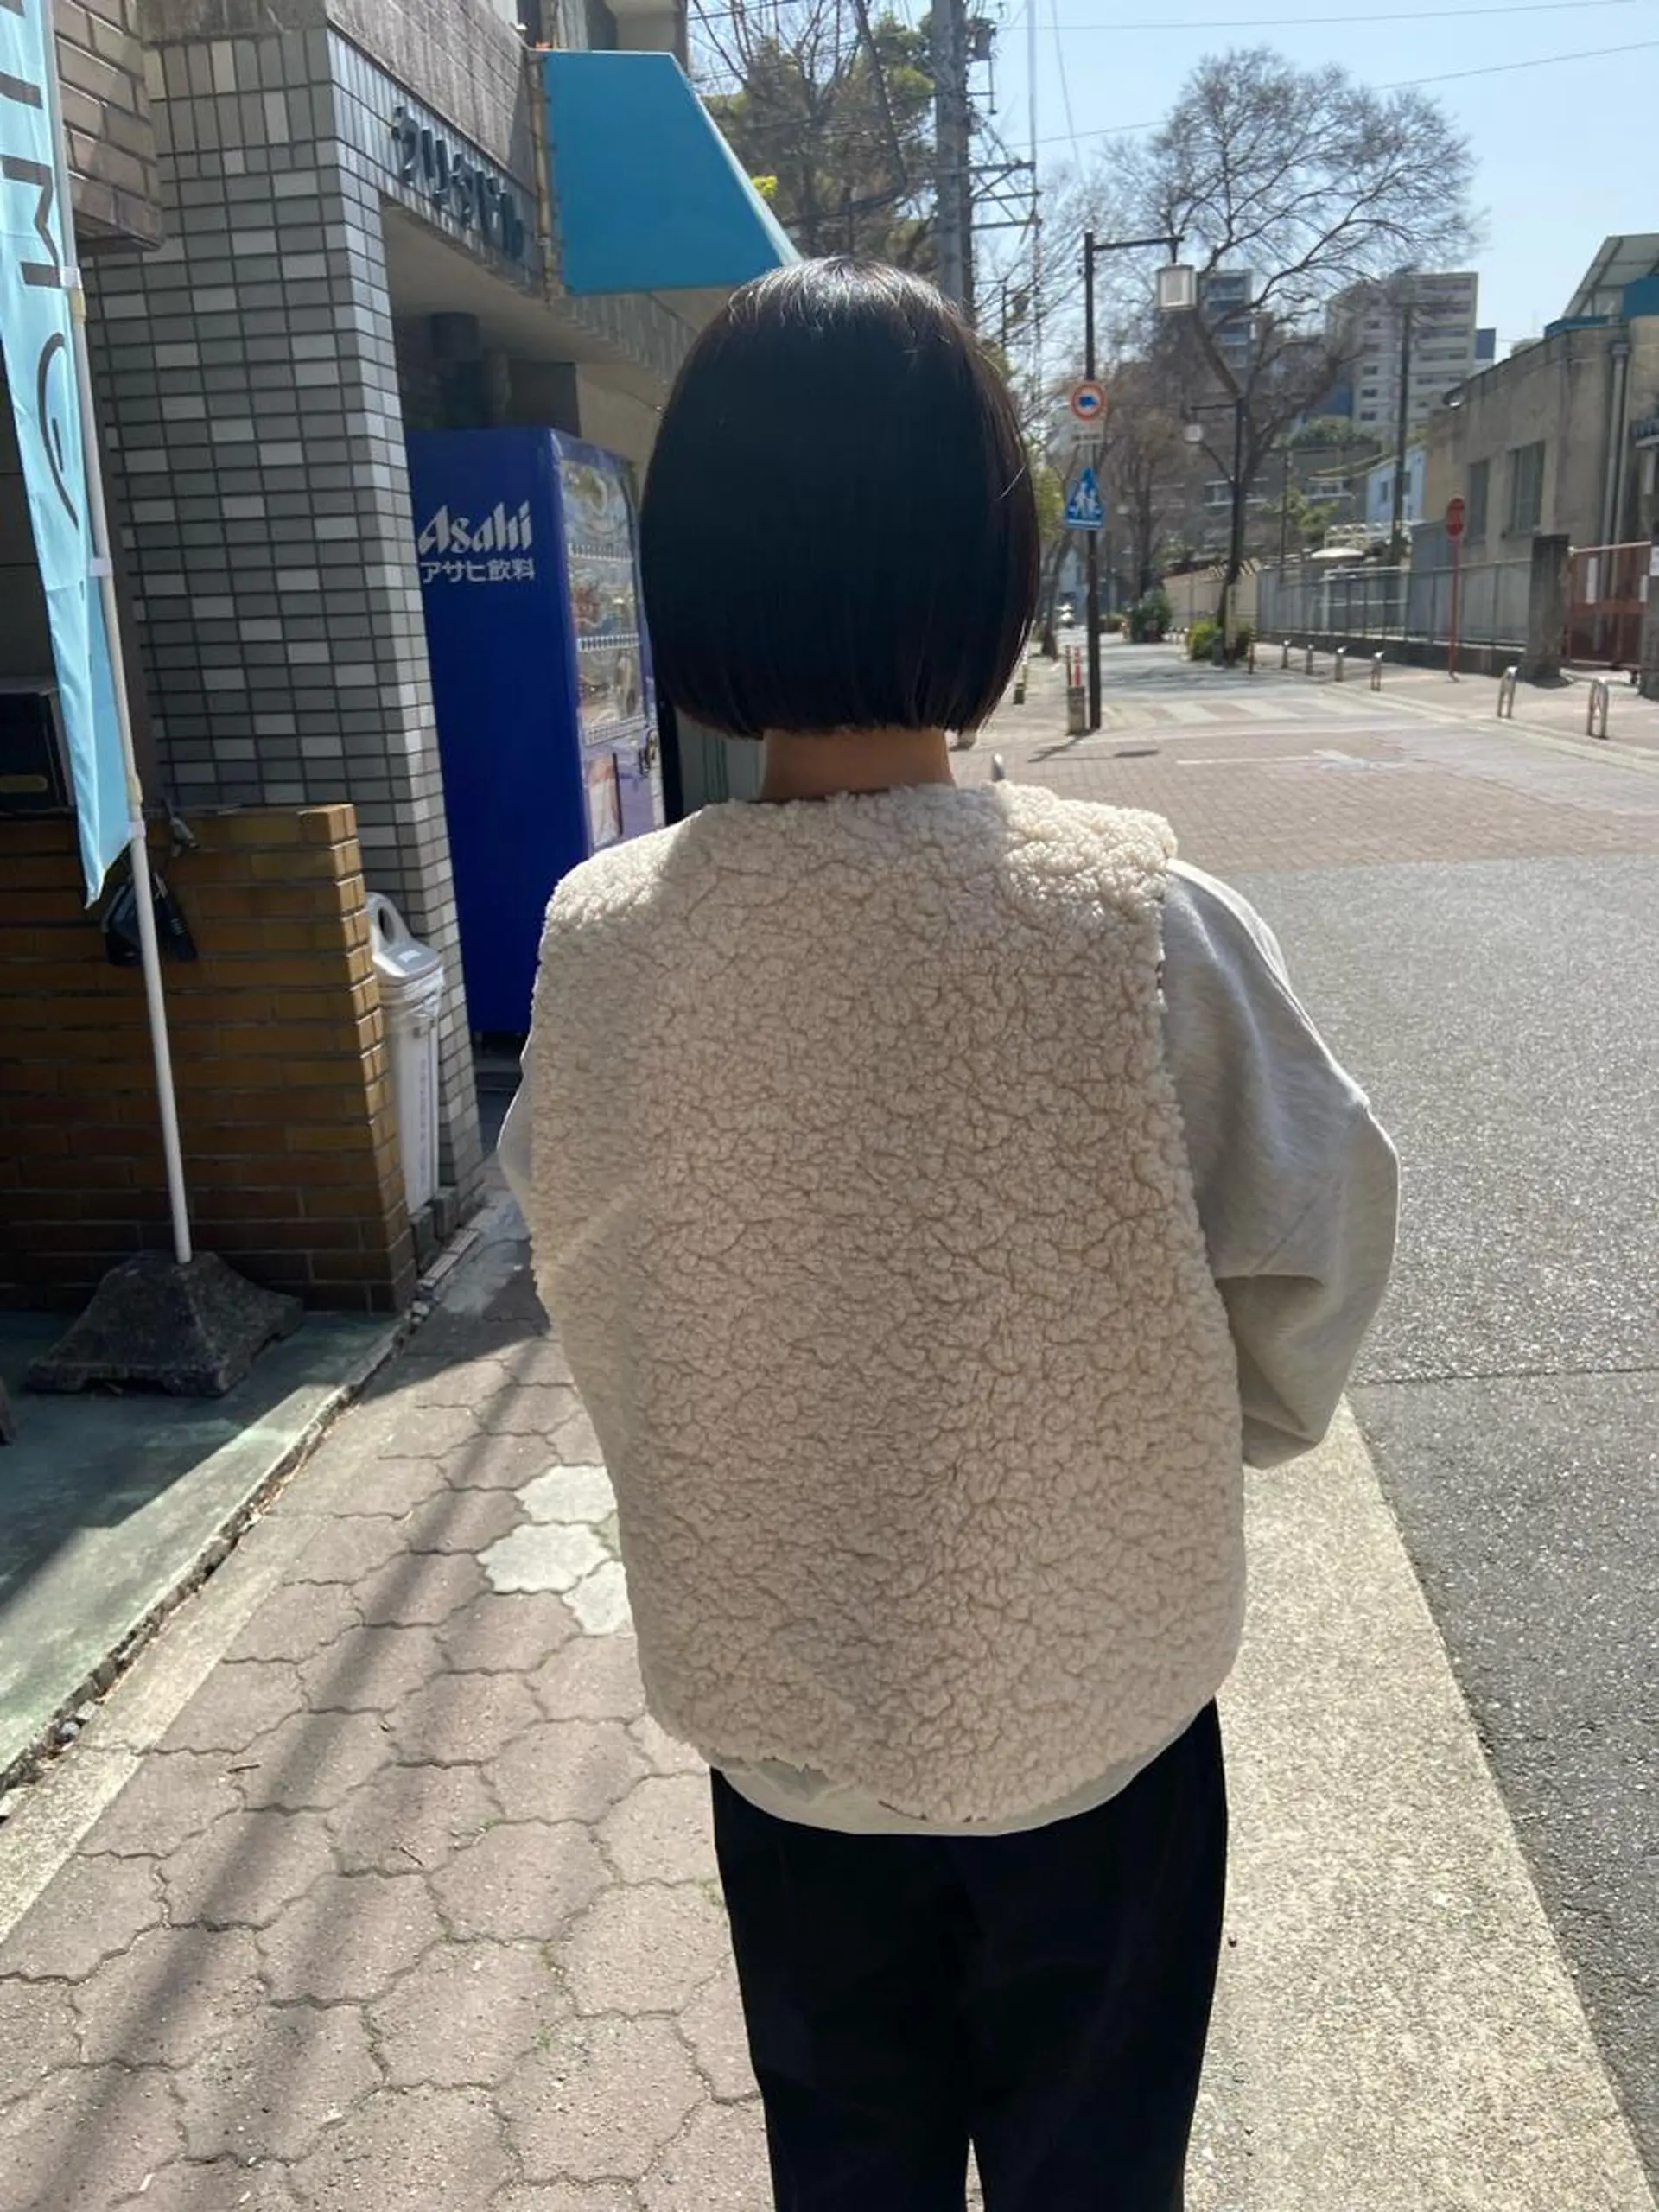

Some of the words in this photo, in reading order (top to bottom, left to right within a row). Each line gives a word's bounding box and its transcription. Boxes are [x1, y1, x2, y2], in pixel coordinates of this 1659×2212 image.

[418, 499, 532, 556] Asahi
[420, 557, 536, 584] アサヒ飲料
